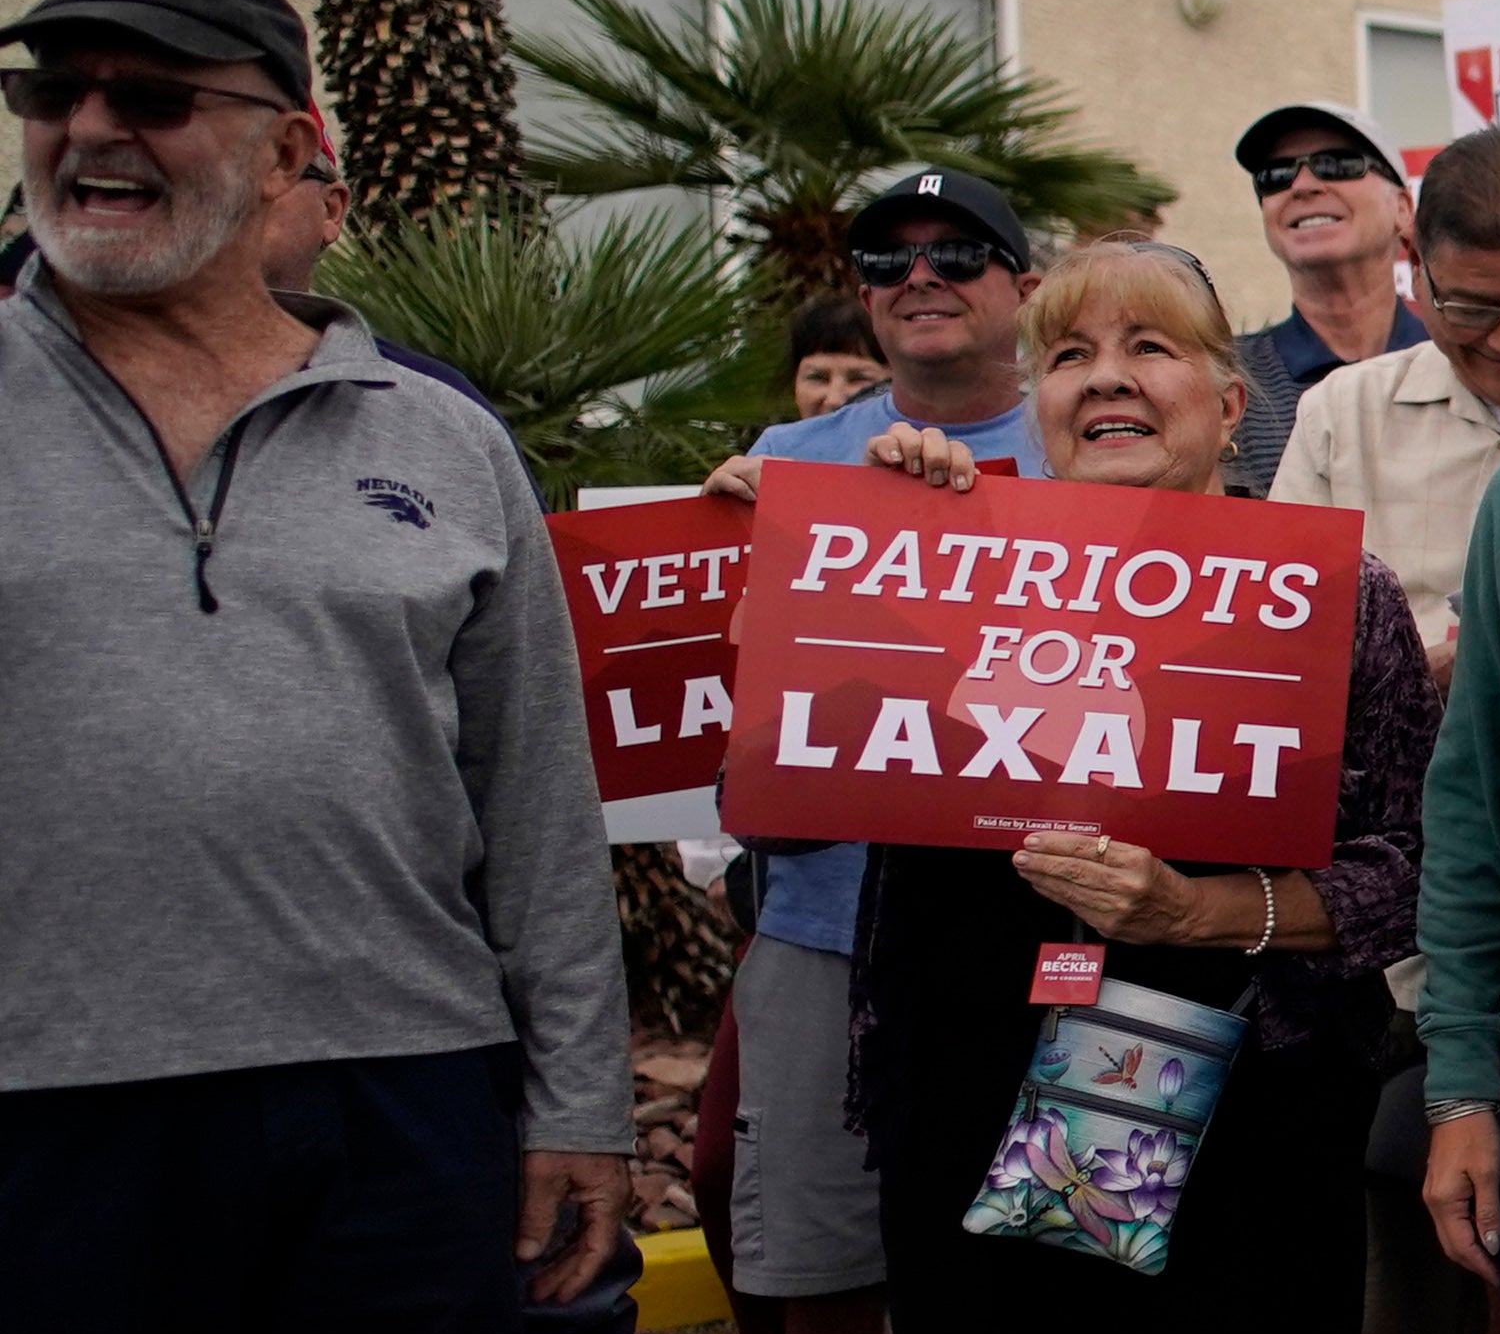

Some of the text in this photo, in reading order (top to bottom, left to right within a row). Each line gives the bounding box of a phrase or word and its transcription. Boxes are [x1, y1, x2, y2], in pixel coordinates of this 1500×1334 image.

[356, 477, 437, 519] NEVADA
[790, 521, 1319, 633] PATRIOTS
[966, 624, 1138, 691] FOR
[775, 689, 1302, 799] LAXALT
[976, 818, 1098, 833] Paid for by Laxalt for Senate
[1041, 961, 1099, 973] BECKER
[1056, 953, 1087, 961] APRIL
